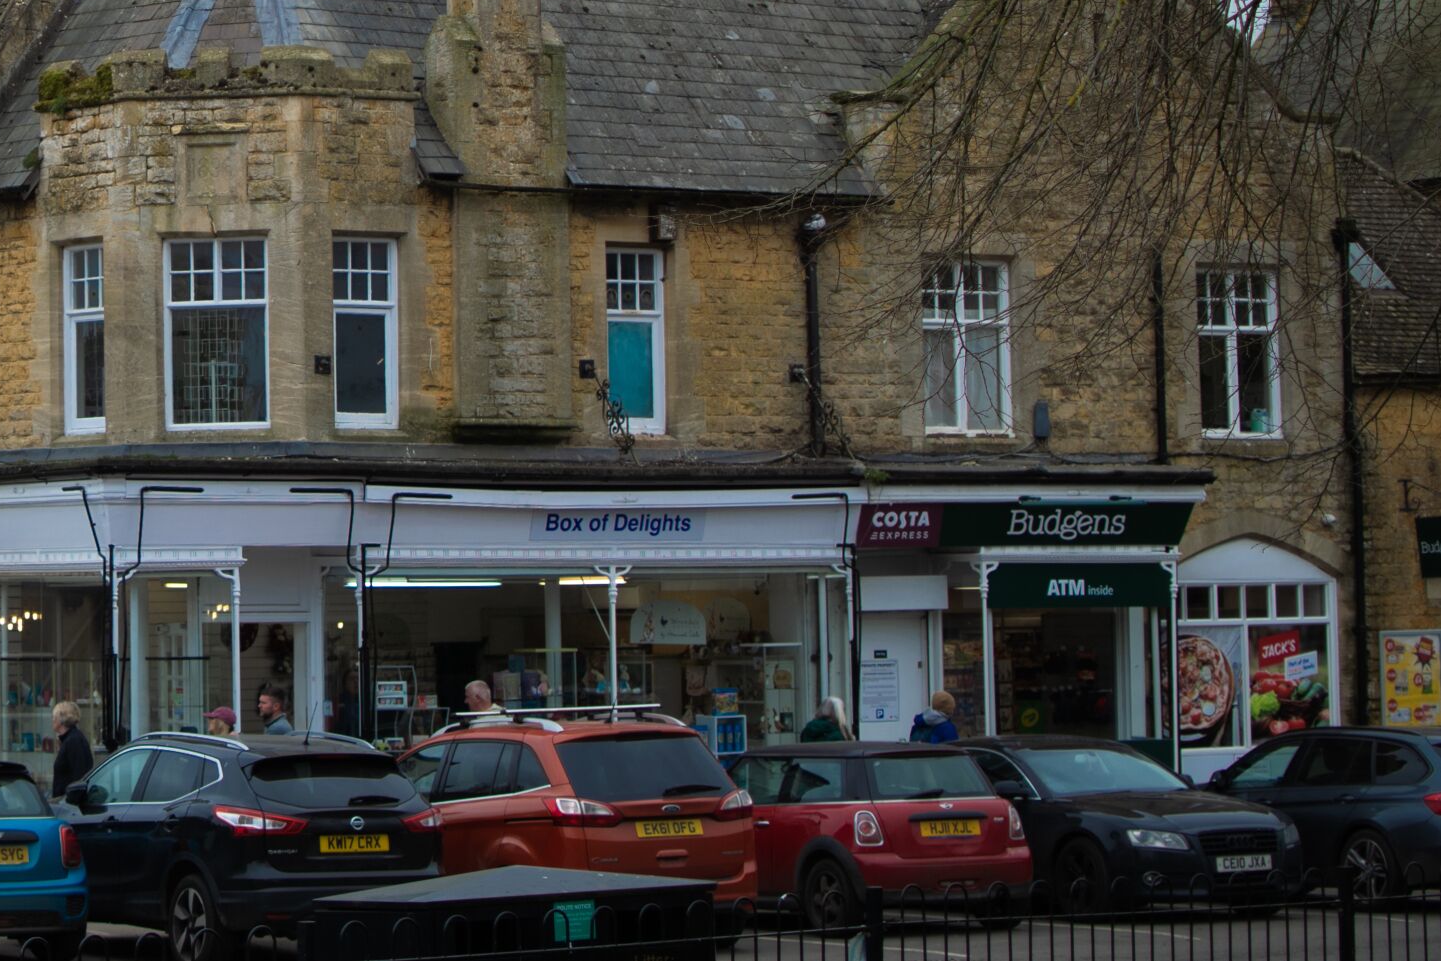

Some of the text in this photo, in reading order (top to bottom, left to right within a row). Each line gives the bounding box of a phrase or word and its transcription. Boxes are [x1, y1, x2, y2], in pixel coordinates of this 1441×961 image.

[545, 513, 692, 537] Box of Delights
[872, 511, 930, 529] COSTA
[1006, 509, 1126, 541] Budgens
[878, 531, 929, 541] EXPRESS
[1421, 540, 1441, 555] Bud
[1047, 579, 1114, 597] ATM inside
[1262, 639, 1296, 659] JACK'S
[643, 821, 696, 836] EK61 OFG
[953, 821, 972, 834] XJL
[357, 835, 382, 849] CRX
[0, 847, 25, 862] SYG
[1223, 856, 1267, 870] CE10 JXA
